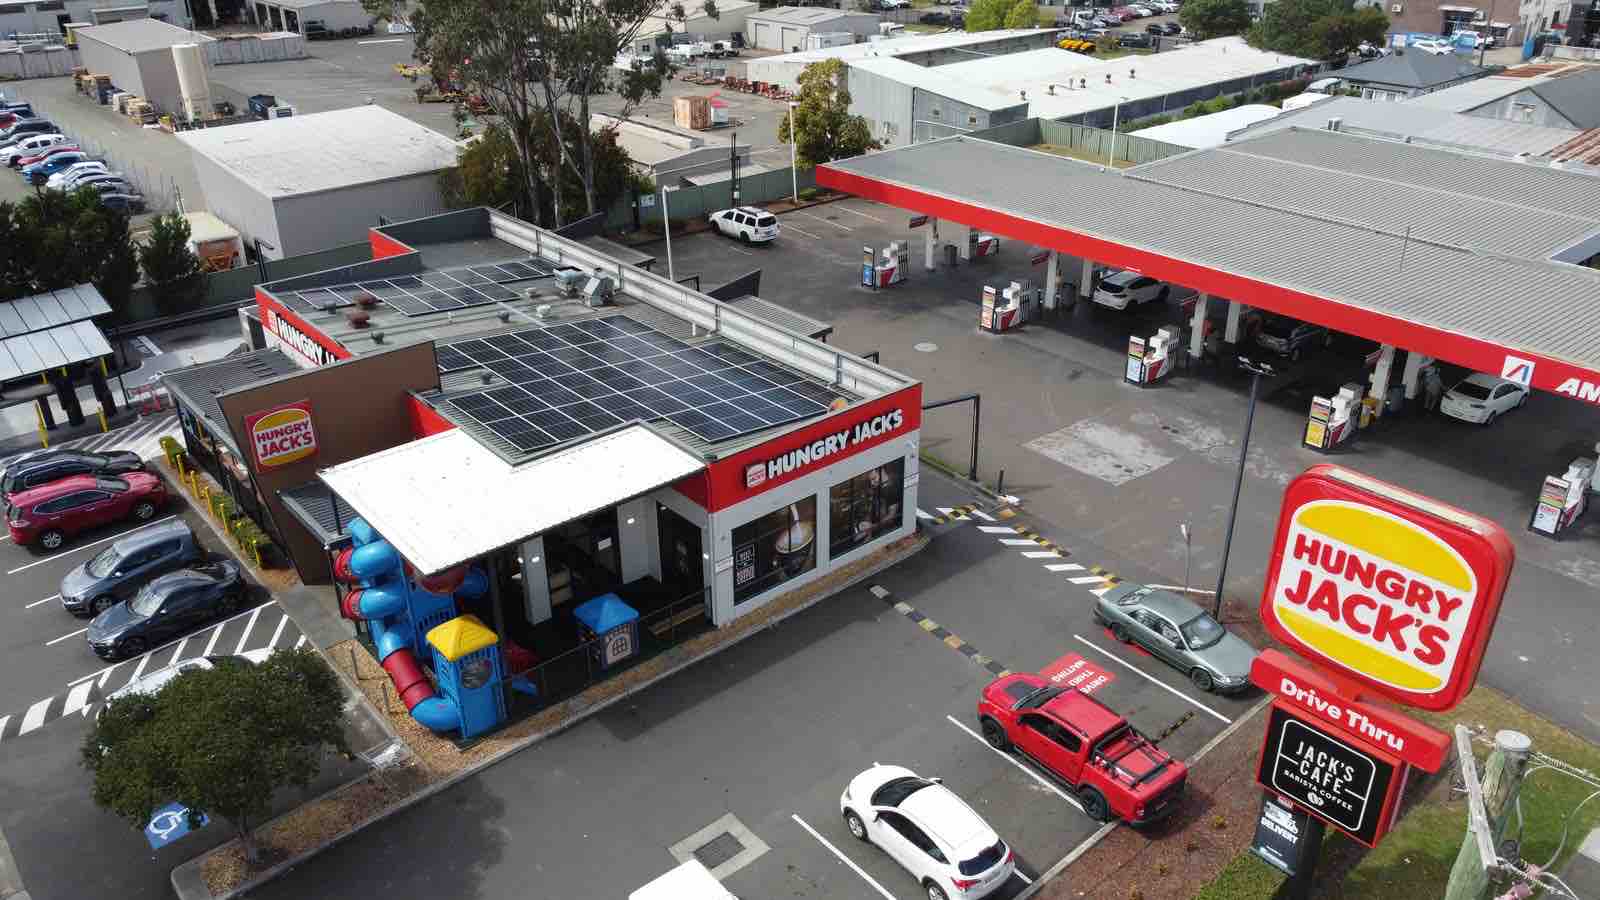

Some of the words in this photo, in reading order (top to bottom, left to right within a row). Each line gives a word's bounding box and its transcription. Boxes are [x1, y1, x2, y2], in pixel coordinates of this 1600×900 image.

[256, 419, 310, 442] HUNGRY
[260, 431, 314, 458] JACK'S
[768, 429, 850, 480] HUNGRY
[1293, 533, 1463, 622] HUNGRY
[1284, 569, 1450, 666] JACK'S
[1051, 660, 1086, 682] WAITING
[1279, 677, 1343, 720] Drive
[1346, 708, 1405, 751] Thru
[1295, 740, 1355, 783] JACK'S
[1299, 759, 1345, 795] CAFE
[1283, 769, 1318, 793] BARISTA
[1319, 788, 1354, 812] COFFEE
